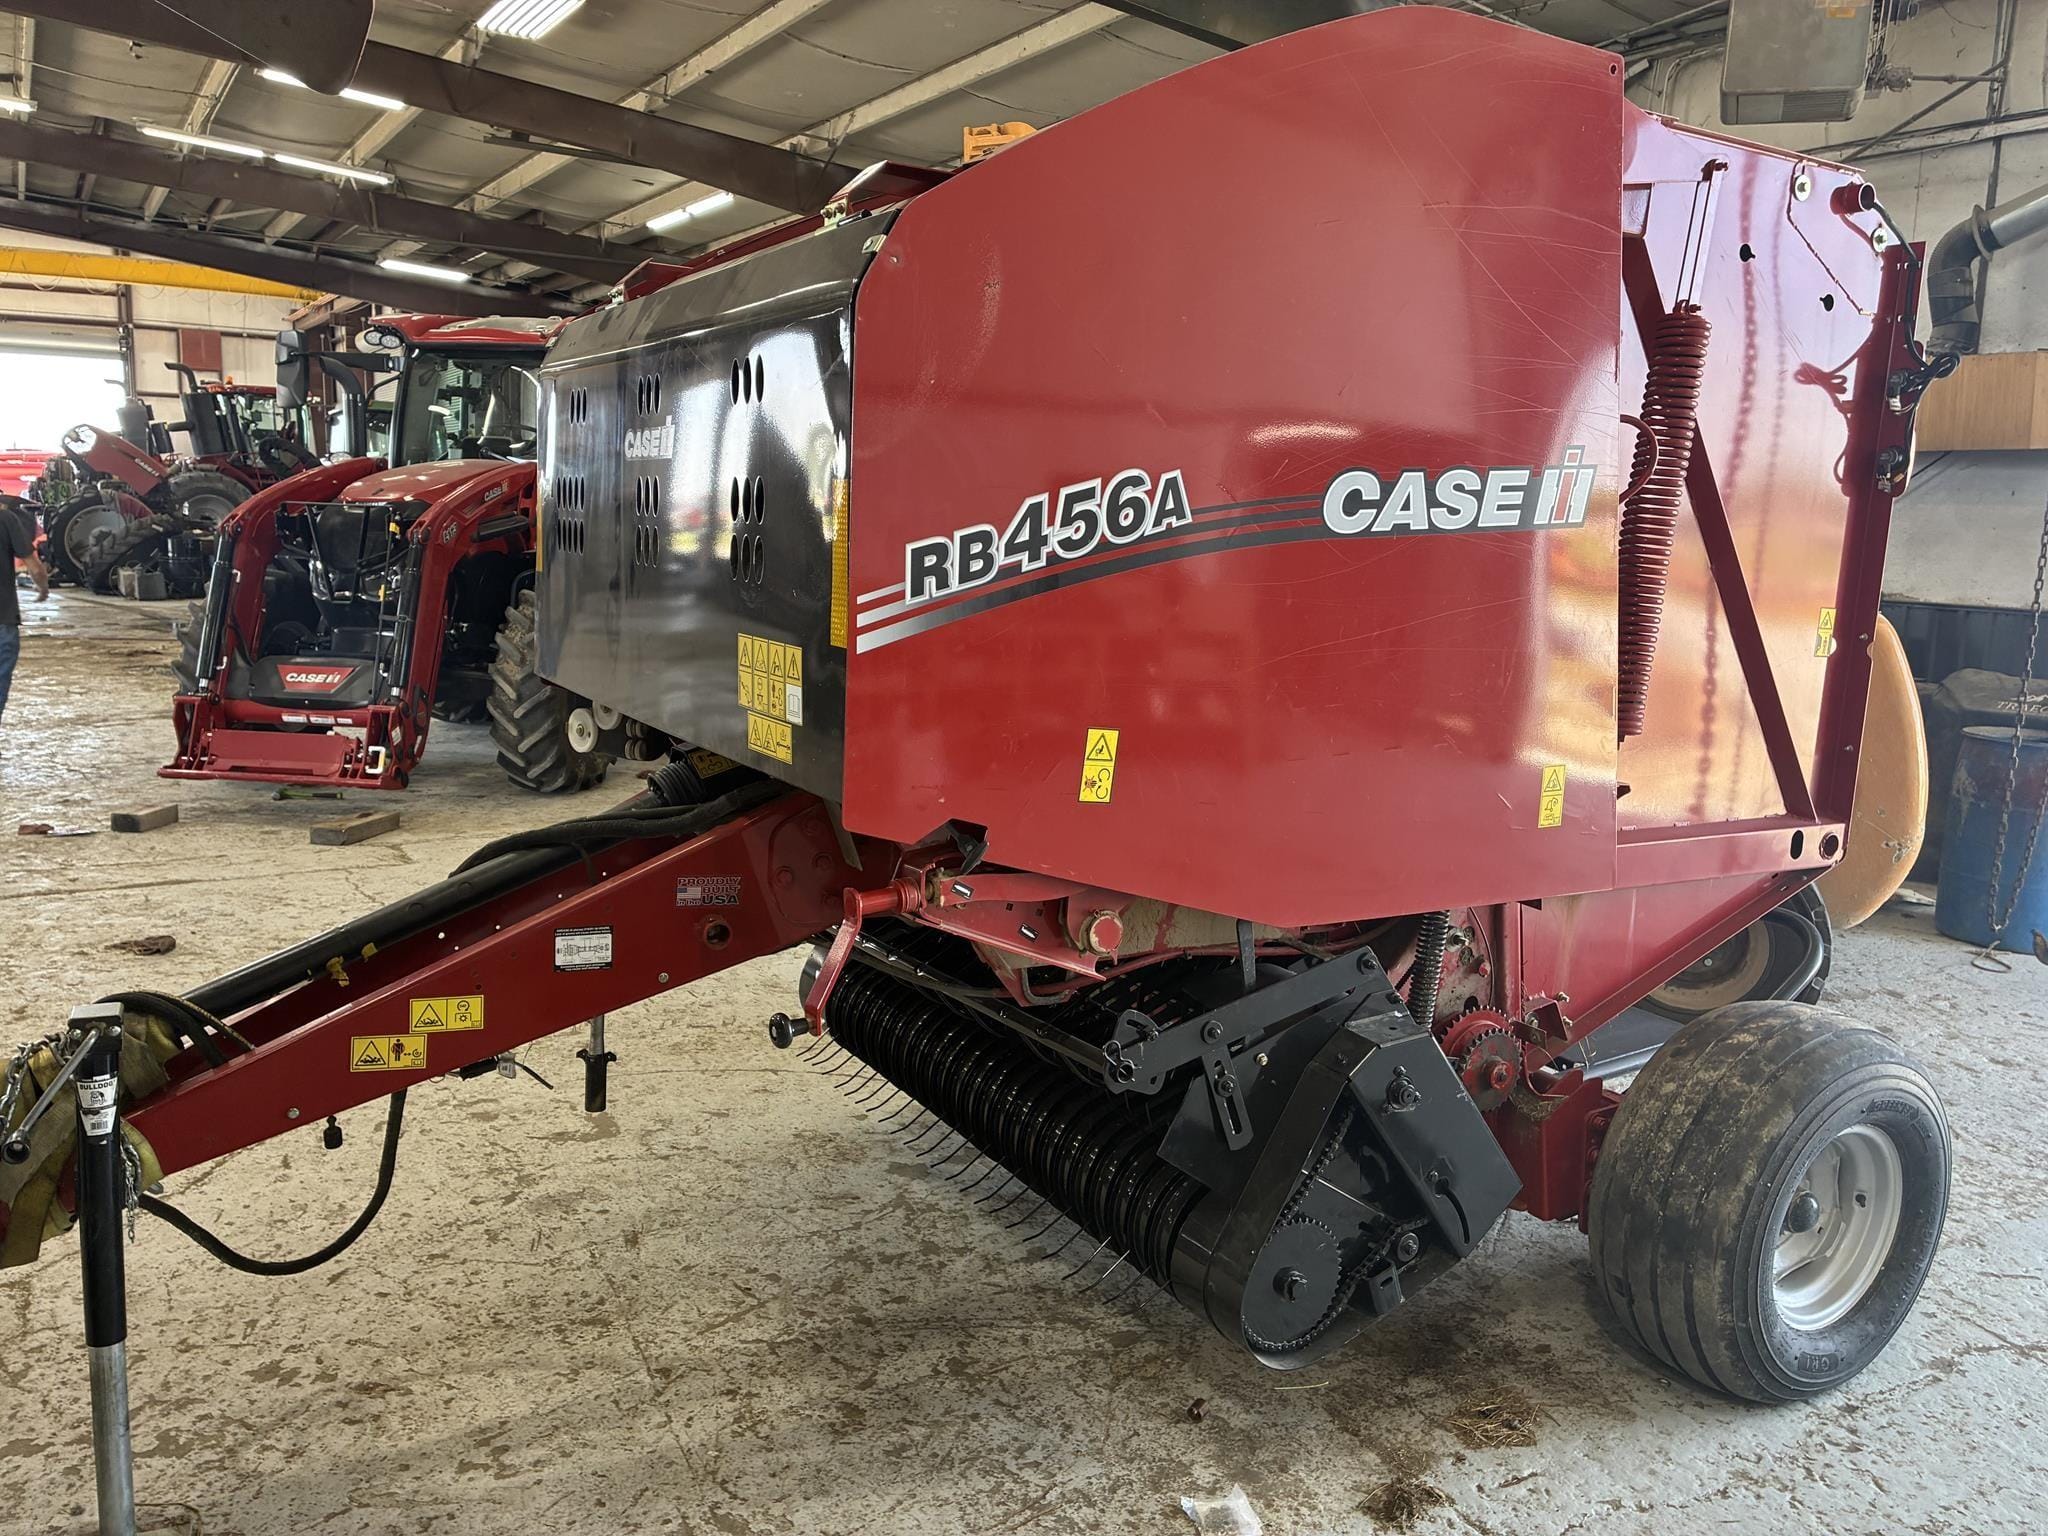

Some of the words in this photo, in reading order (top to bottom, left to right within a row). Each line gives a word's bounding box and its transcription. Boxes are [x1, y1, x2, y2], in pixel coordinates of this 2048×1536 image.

[624, 428, 660, 458] CASE
[484, 486, 502, 502] CASE
[1323, 469, 1531, 534] CASE
[905, 468, 1193, 605] RB456A
[285, 672, 327, 684] CASE
[677, 876, 741, 887] PROUDLY
[702, 886, 741, 895] BUILT
[702, 894, 740, 906] USA
[79, 1081, 114, 1091] BULLDOG
